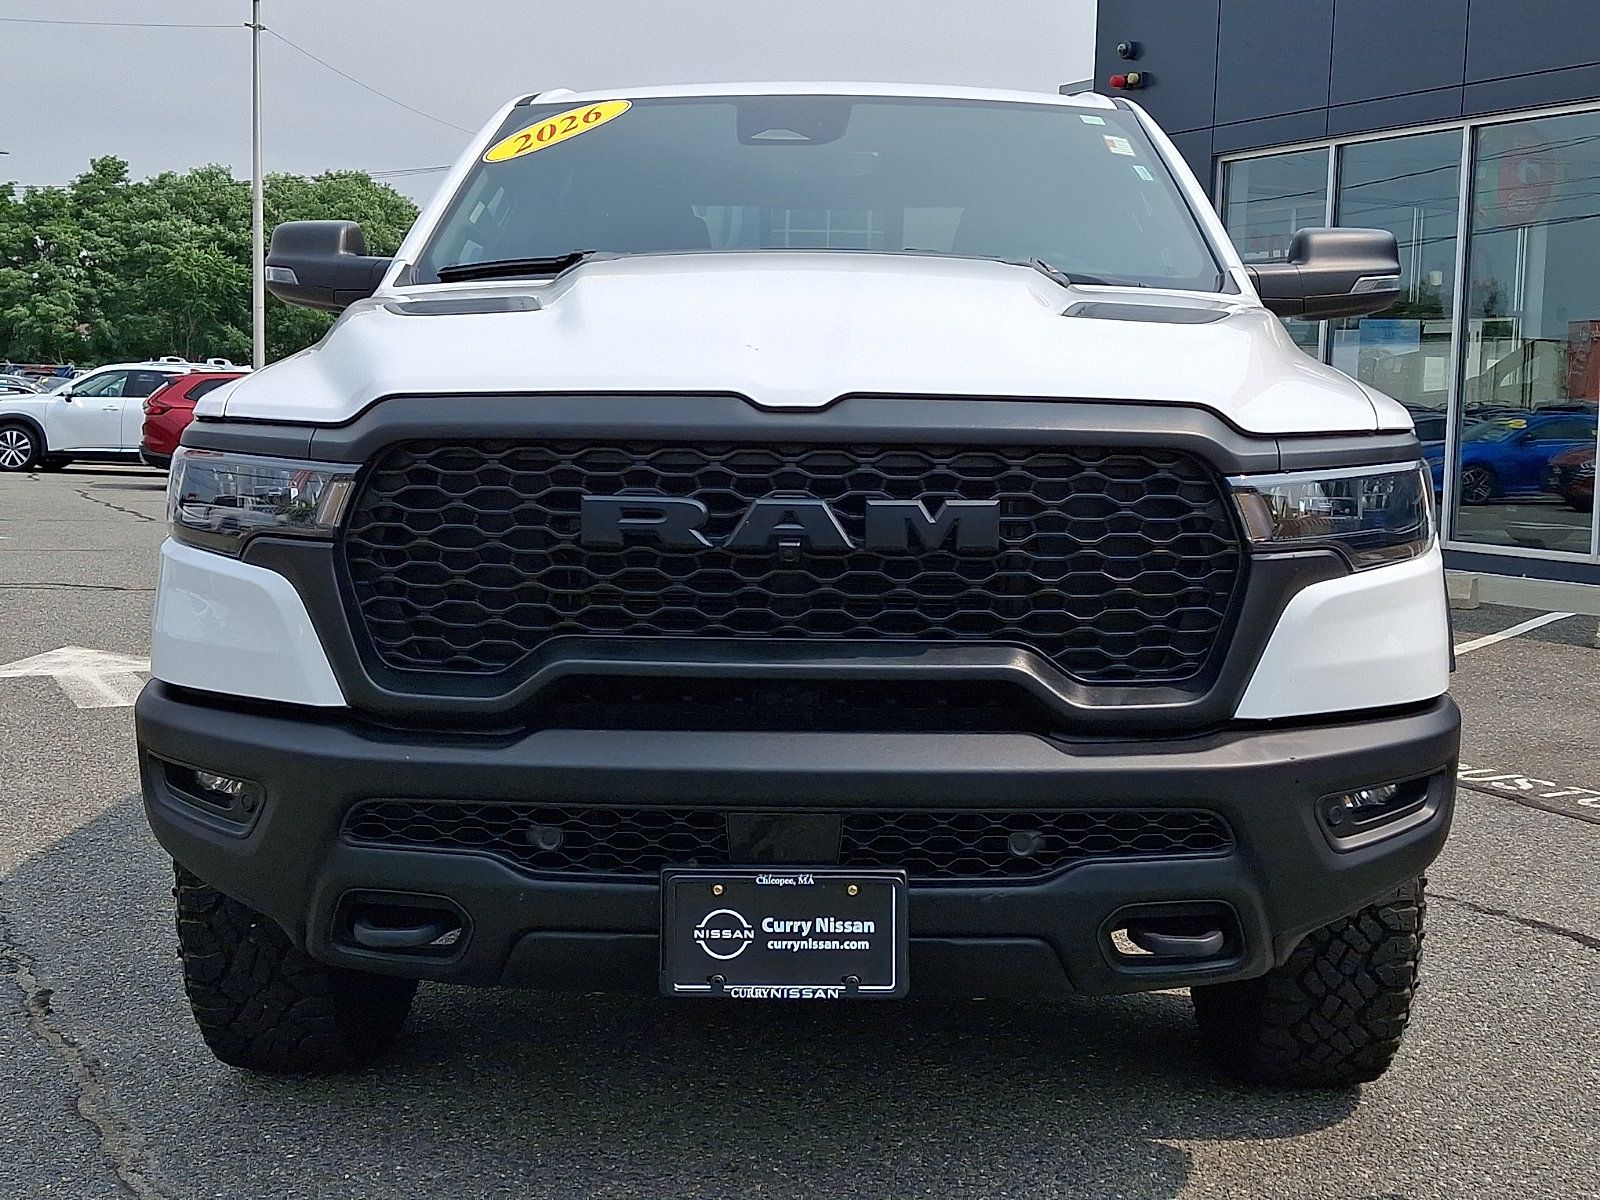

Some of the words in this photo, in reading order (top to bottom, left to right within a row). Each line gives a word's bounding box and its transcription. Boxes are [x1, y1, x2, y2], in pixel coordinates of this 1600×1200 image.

[514, 106, 602, 153] 2026
[581, 494, 1000, 552] RAM
[798, 875, 814, 885] MA
[694, 929, 754, 939] NISSAN
[762, 918, 812, 936] Curry
[816, 917, 875, 933] Nissan
[767, 938, 870, 952] currynissan.com
